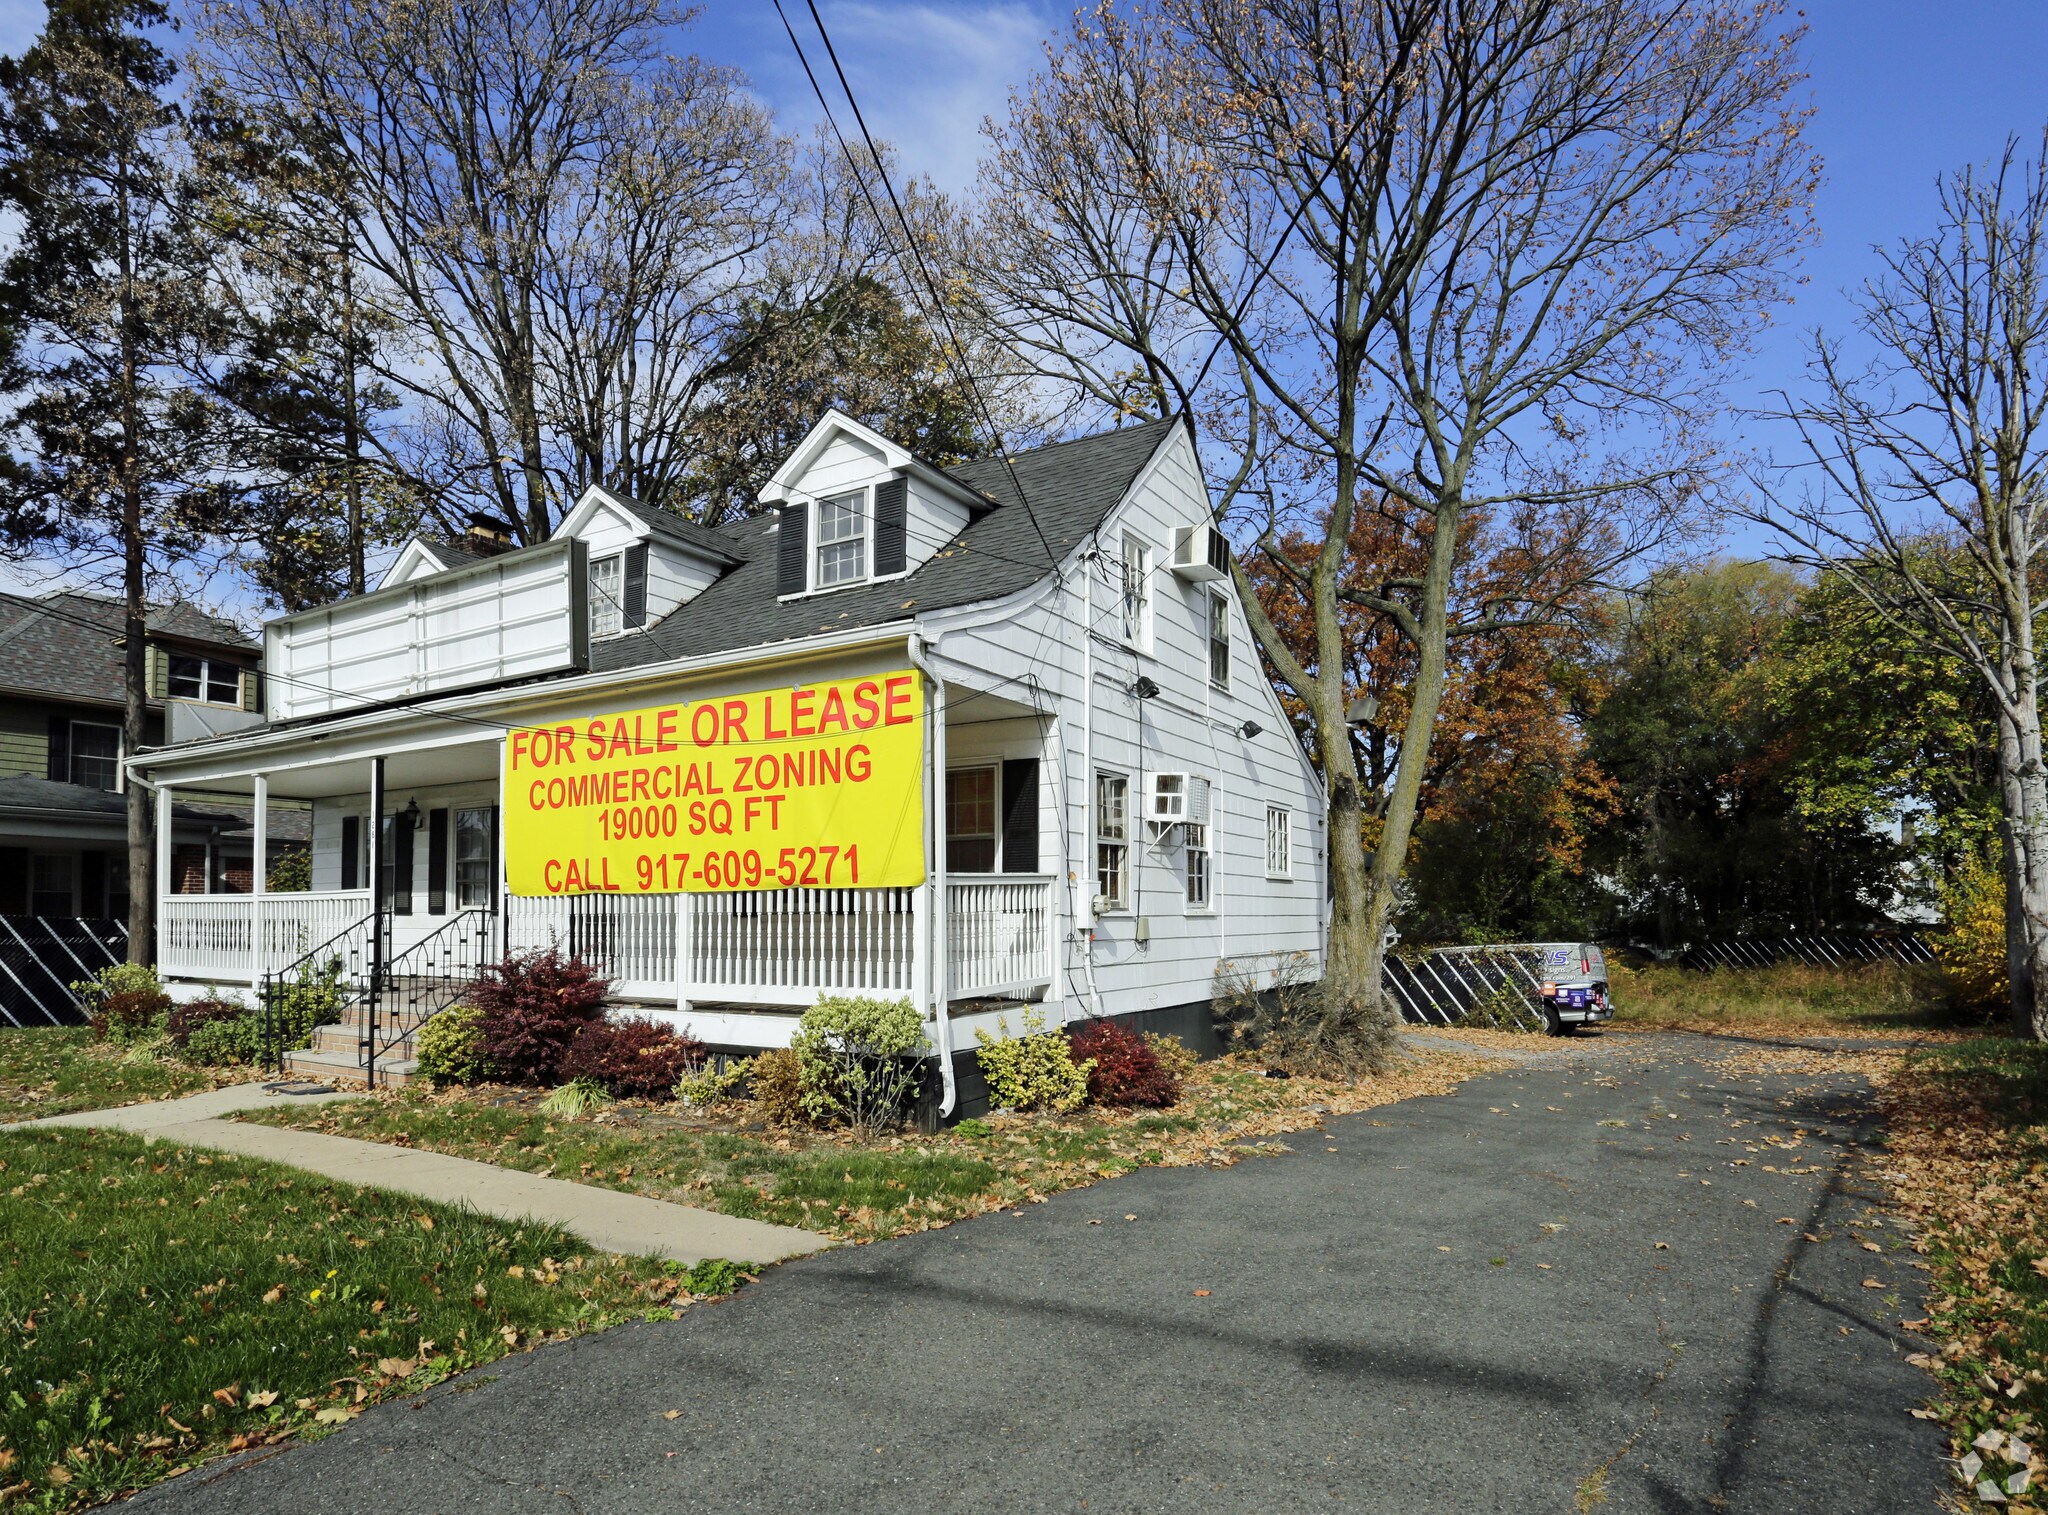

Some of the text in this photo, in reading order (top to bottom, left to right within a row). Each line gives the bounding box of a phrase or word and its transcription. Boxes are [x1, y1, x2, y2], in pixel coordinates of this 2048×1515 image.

[512, 676, 914, 771] FOR SALE OR LEASE
[529, 745, 872, 811] COMMERCIAL ZONING
[598, 795, 786, 841] 19000 SQ FT
[544, 844, 859, 892] CALL 917-609-5271
